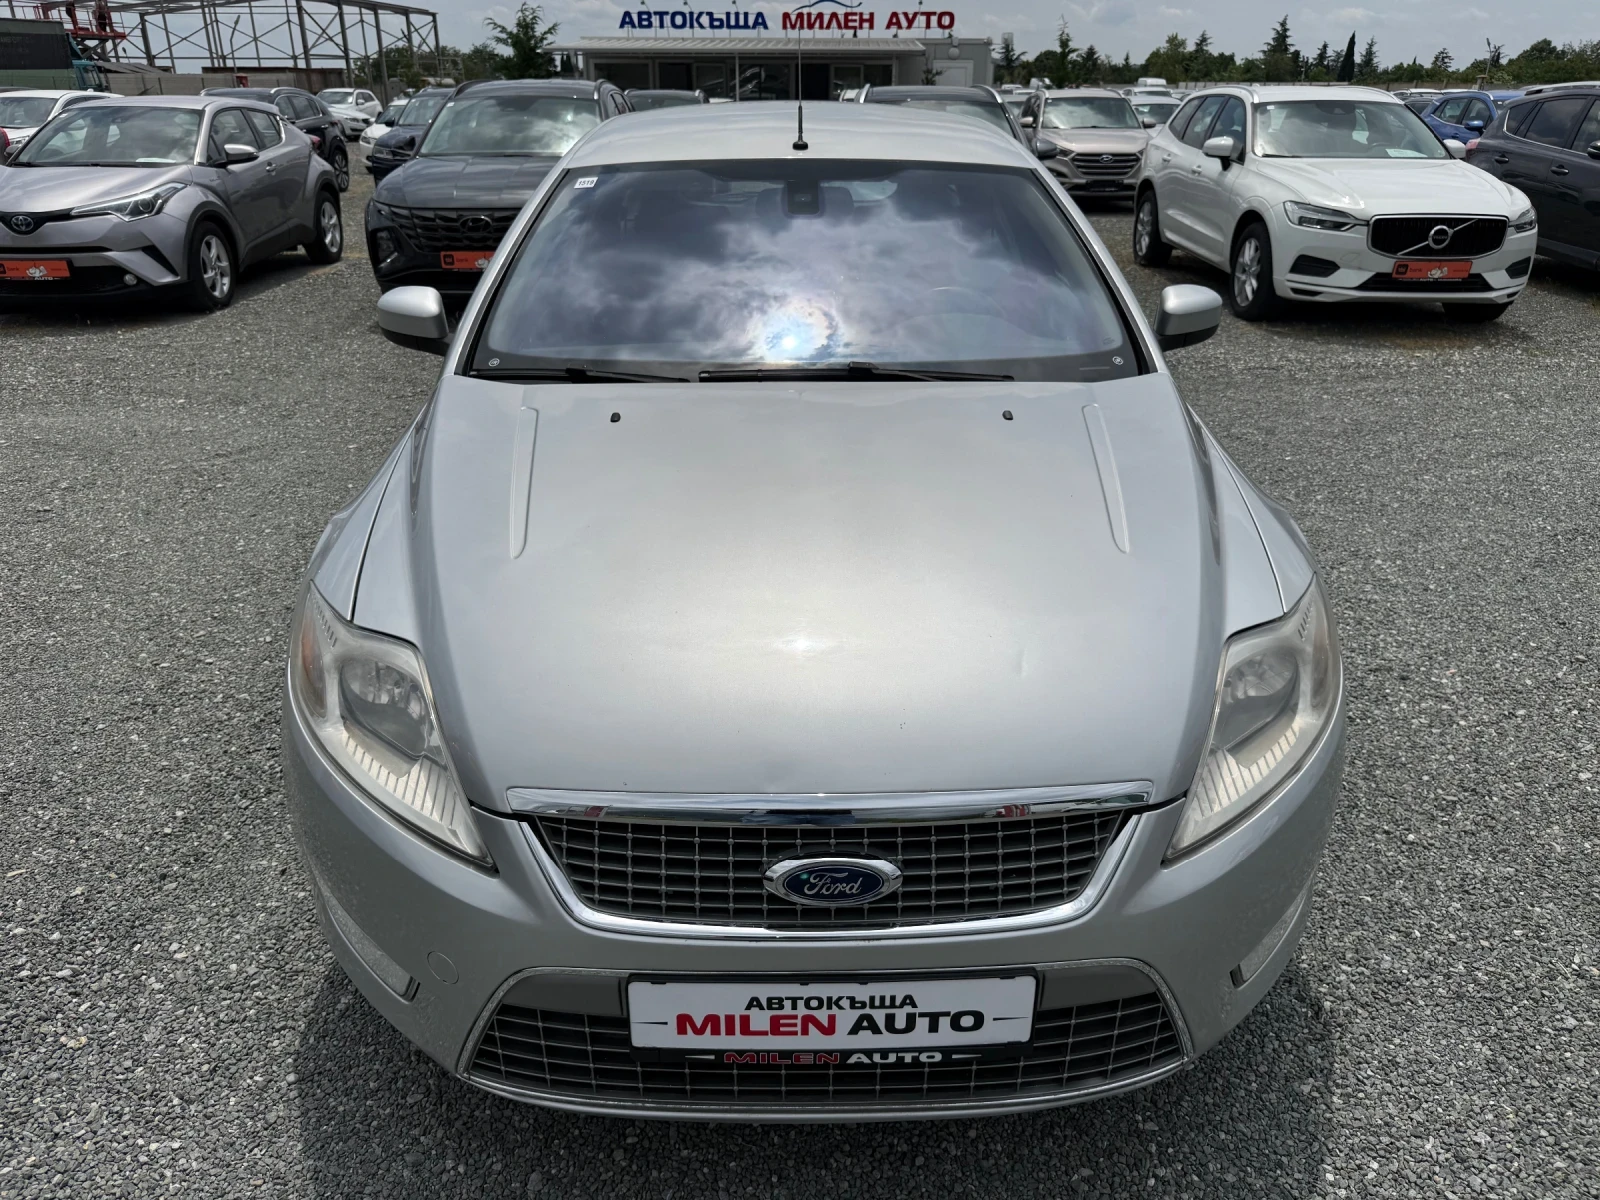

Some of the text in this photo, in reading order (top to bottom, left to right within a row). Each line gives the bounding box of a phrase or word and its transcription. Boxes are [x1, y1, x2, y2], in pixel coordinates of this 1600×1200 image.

[782, 11, 875, 31] МИЛЕН
[885, 11, 956, 31] АУТО
[804, 872, 862, 895] Ford
[676, 1010, 985, 1036] MILEN AUTO
[724, 1051, 943, 1065] MILEN AUTO
